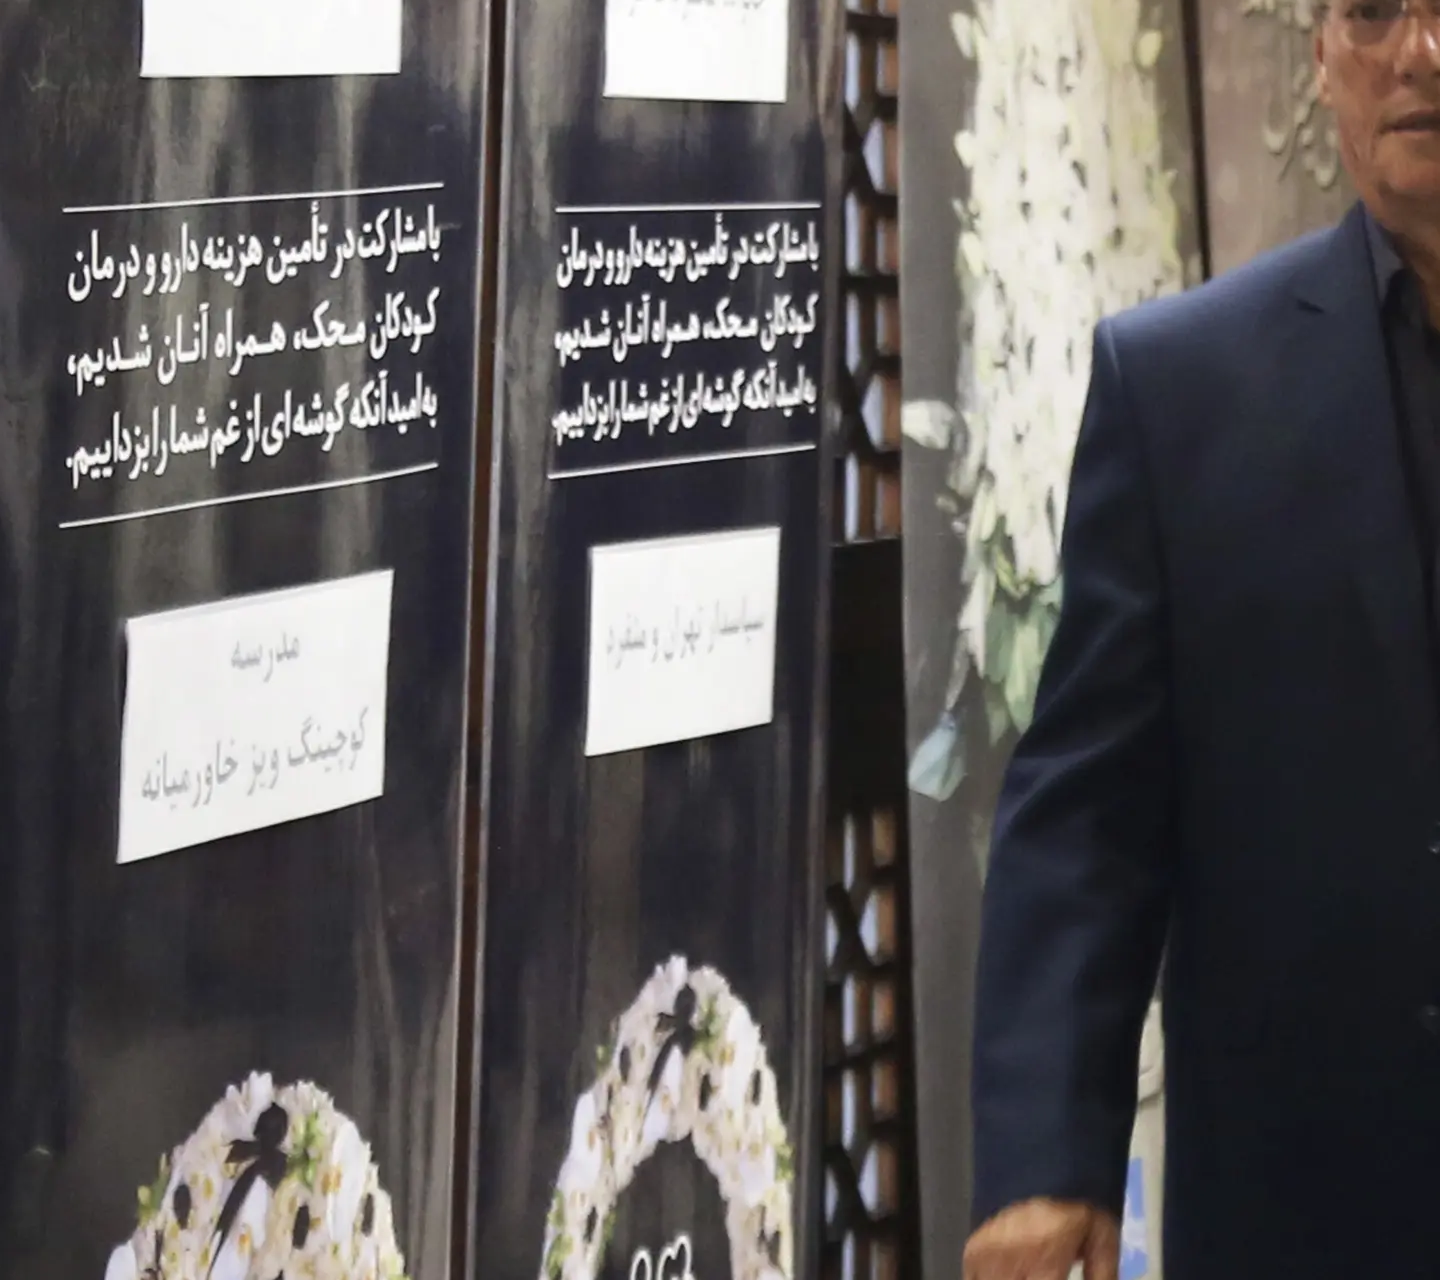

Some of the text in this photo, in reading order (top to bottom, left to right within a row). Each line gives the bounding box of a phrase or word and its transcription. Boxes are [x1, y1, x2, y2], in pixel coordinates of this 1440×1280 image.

[68, 203, 441, 302] با مشارکت در تأمین هزینه دارو و درمان
[157, 302, 210, 384] آنان
[214, 308, 286, 375] همراه
[370, 287, 441, 359] کودکان
[170, 404, 209, 455] شما
[240, 392, 260, 463] از
[349, 370, 389, 429] آنکه
[388, 371, 422, 434] امید
[422, 386, 438, 428] به
[152, 406, 168, 476] را
[210, 399, 240, 469] غم
[230, 632, 300, 683] مدرسه
[288, 705, 369, 773] کوچینگ
